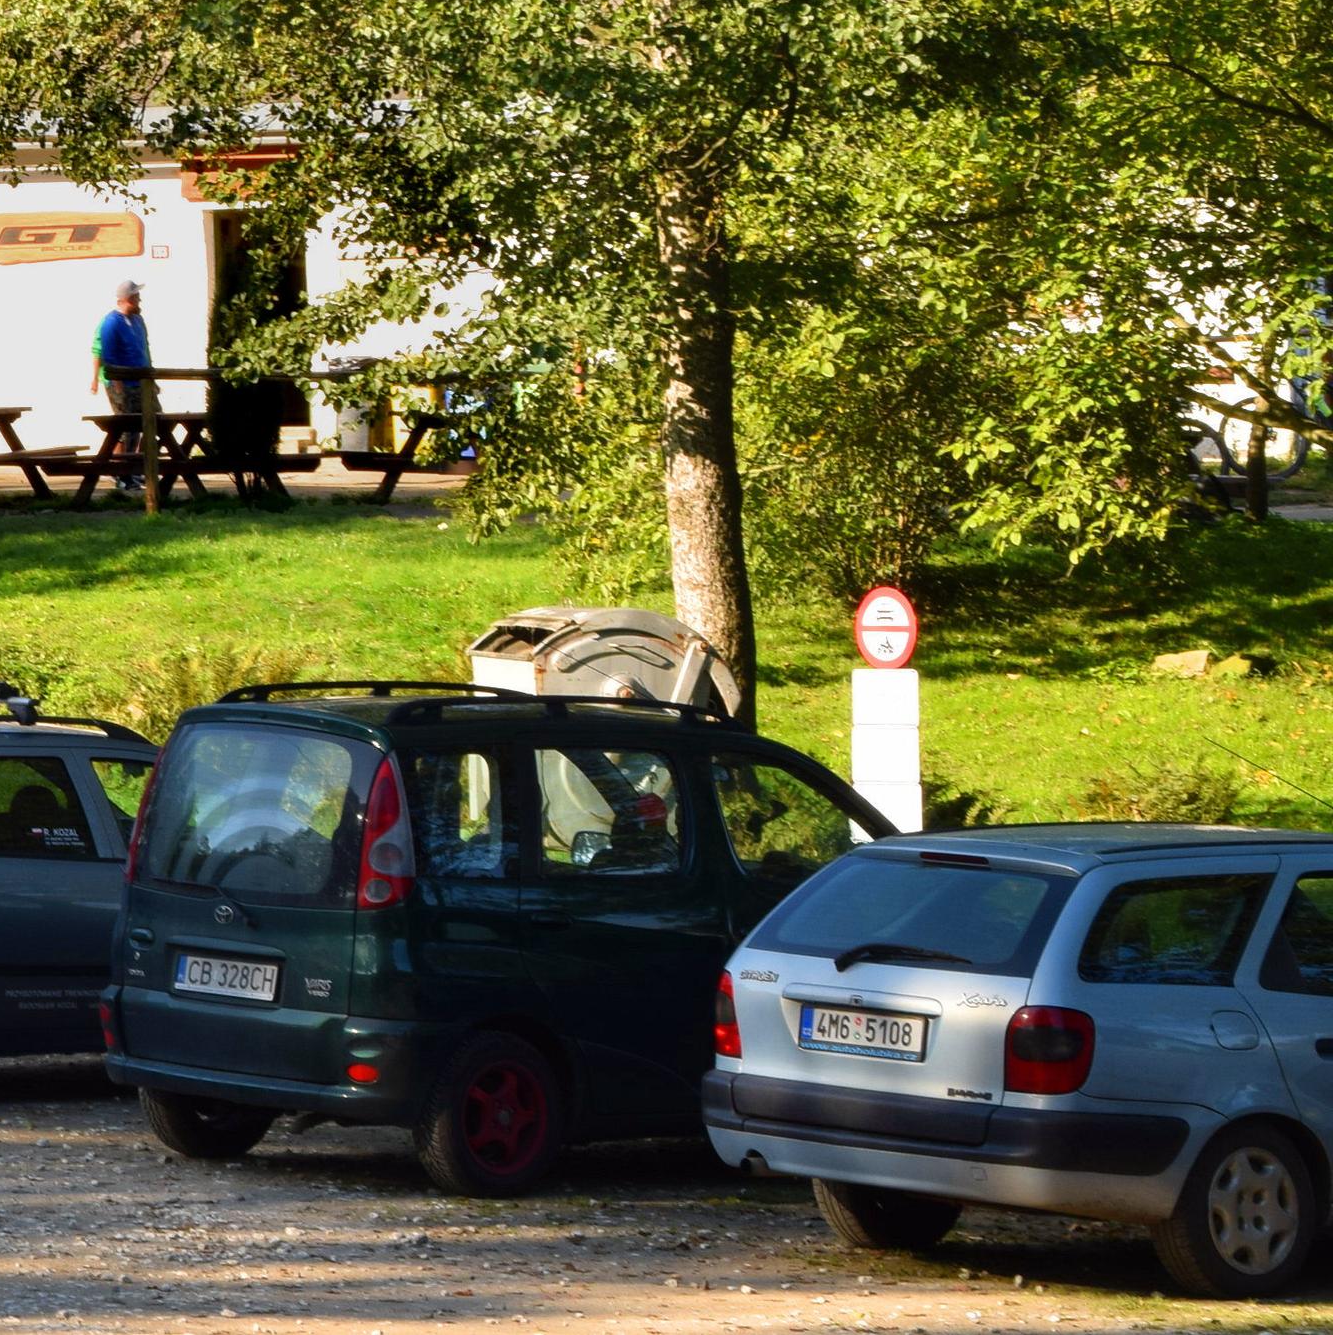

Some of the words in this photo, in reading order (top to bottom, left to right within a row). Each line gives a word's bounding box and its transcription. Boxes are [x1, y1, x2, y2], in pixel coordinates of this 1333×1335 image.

[188, 959, 213, 985] CB
[218, 961, 276, 993] 328CH
[817, 1012, 851, 1040] 4M6
[865, 1017, 913, 1047] 5108
